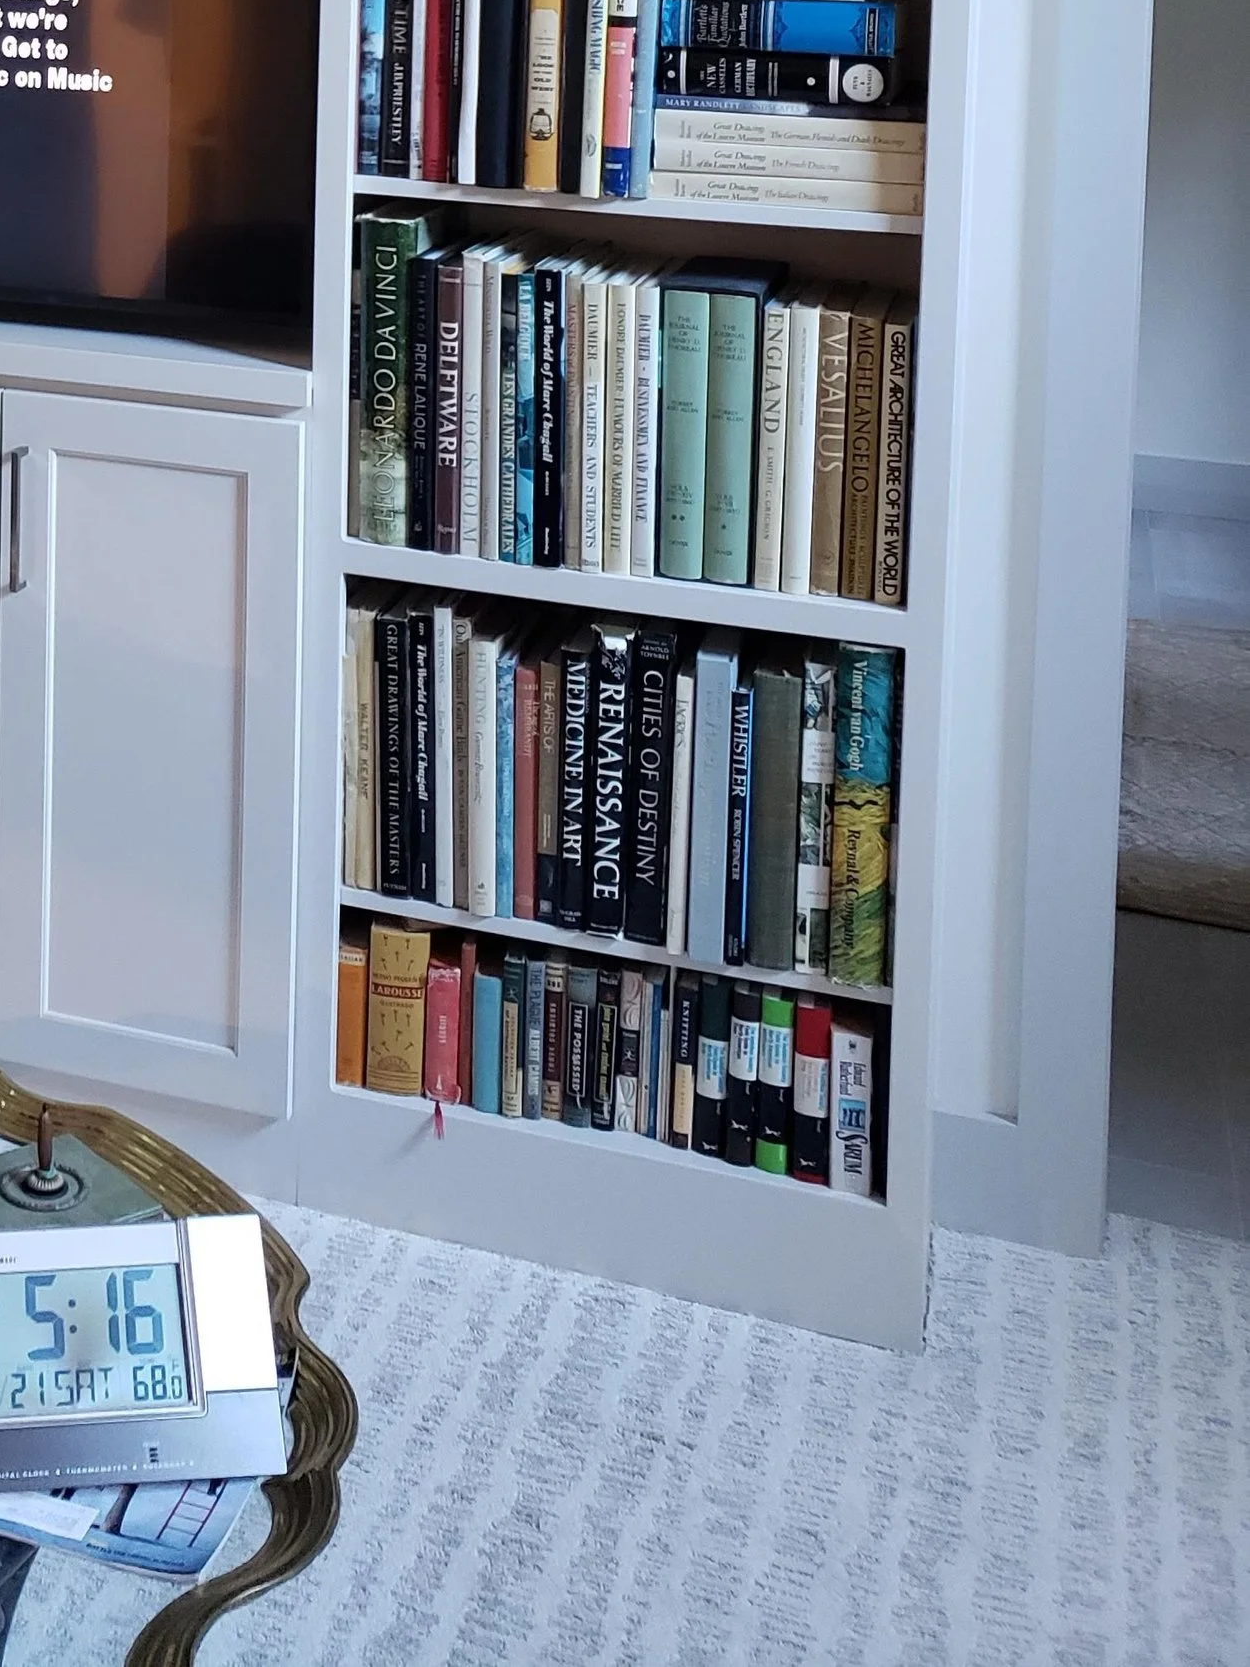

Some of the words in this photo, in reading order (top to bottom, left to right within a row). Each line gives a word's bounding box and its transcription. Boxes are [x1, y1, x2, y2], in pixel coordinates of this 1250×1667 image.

[7, 8, 69, 31] we're
[696, 3, 709, 42] Bartlett's
[707, 6, 719, 45] Familiar
[718, 1, 732, 49] Quotations
[1, 36, 42, 59] Get
[45, 38, 69, 60] to
[14, 70, 42, 89] on
[47, 66, 114, 92] Music
[706, 63, 717, 89] NEW
[373, 244, 398, 319] VINCI
[543, 299, 555, 325] The
[586, 302, 599, 361] DAUMIER
[373, 324, 397, 361] DA
[542, 324, 555, 360] World
[637, 313, 651, 361] DAUMIER
[890, 330, 906, 377] GREAT
[502, 372, 516, 395] LES
[541, 361, 554, 377] of
[764, 311, 785, 434] ENGLAND
[437, 321, 459, 468] DELFTWARE
[541, 377, 554, 413] Marc
[636, 376, 650, 448] BUSINESSMEN
[817, 330, 849, 474] VESALIUS
[850, 321, 875, 494] MICHELANGELO
[501, 397, 516, 459] GRANDES
[585, 384, 598, 448] TEACHERS
[885, 377, 905, 486] ARCHITECTURE
[371, 367, 397, 522] LEONARDO
[540, 413, 554, 463] Chagall
[462, 391, 480, 544] STOCKHOLM
[585, 454, 597, 480] AND
[635, 450, 649, 473] AND
[500, 461, 516, 554] CATHEDRALES
[584, 485, 597, 549] STUDENTS
[634, 477, 648, 524] FINANCE
[885, 487, 901, 512] OF
[884, 512, 901, 540] THE
[882, 539, 900, 597] WORLD
[386, 624, 399, 672] GREAT
[455, 623, 467, 646] Our
[416, 644, 428, 668] The
[455, 647, 466, 700] American
[416, 667, 428, 703] World
[475, 651, 487, 725] HUNTING
[544, 680, 556, 702] THE
[642, 669, 664, 739] CITIES
[850, 659, 869, 711] Vincent
[359, 702, 369, 751] WALTER
[386, 674, 400, 752] DRAWINGS
[415, 703, 427, 720] of
[455, 701, 466, 734] Game
[543, 703, 555, 736] ARTS
[564, 660, 587, 780] MEDICINE
[849, 711, 863, 734] van
[415, 720, 428, 752] Marc
[455, 736, 466, 763] Birds
[543, 736, 554, 754] OF
[731, 704, 750, 797] WHISTLER
[847, 734, 865, 772] Gogh
[359, 758, 368, 800] KEANE
[387, 757, 400, 777] OF
[415, 752, 429, 801] Chagall
[641, 748, 662, 782] OF
[387, 782, 400, 811] THE
[563, 787, 583, 812] IN
[593, 679, 626, 900] RENAISSANCE
[562, 816, 582, 866] ART
[635, 788, 659, 886] DESTINY
[732, 808, 743, 837] ROBIN
[388, 812, 401, 876] MASTERS
[730, 838, 742, 881] SPENCER
[372, 984, 423, 999] LAROUSSE
[529, 968, 542, 989] THE
[528, 990, 542, 1027] PLAGUE
[573, 1009, 583, 1029] THE
[528, 1027, 541, 1063] ALBERT
[680, 1000, 691, 1059] KNITTING
[528, 1064, 540, 1096] CAMUS
[571, 1031, 582, 1091] POSSESSED
[835, 1130, 869, 1176] SARUM
[25, 1269, 164, 1361] 5:16
[54, 1367, 114, 1407] SAT
